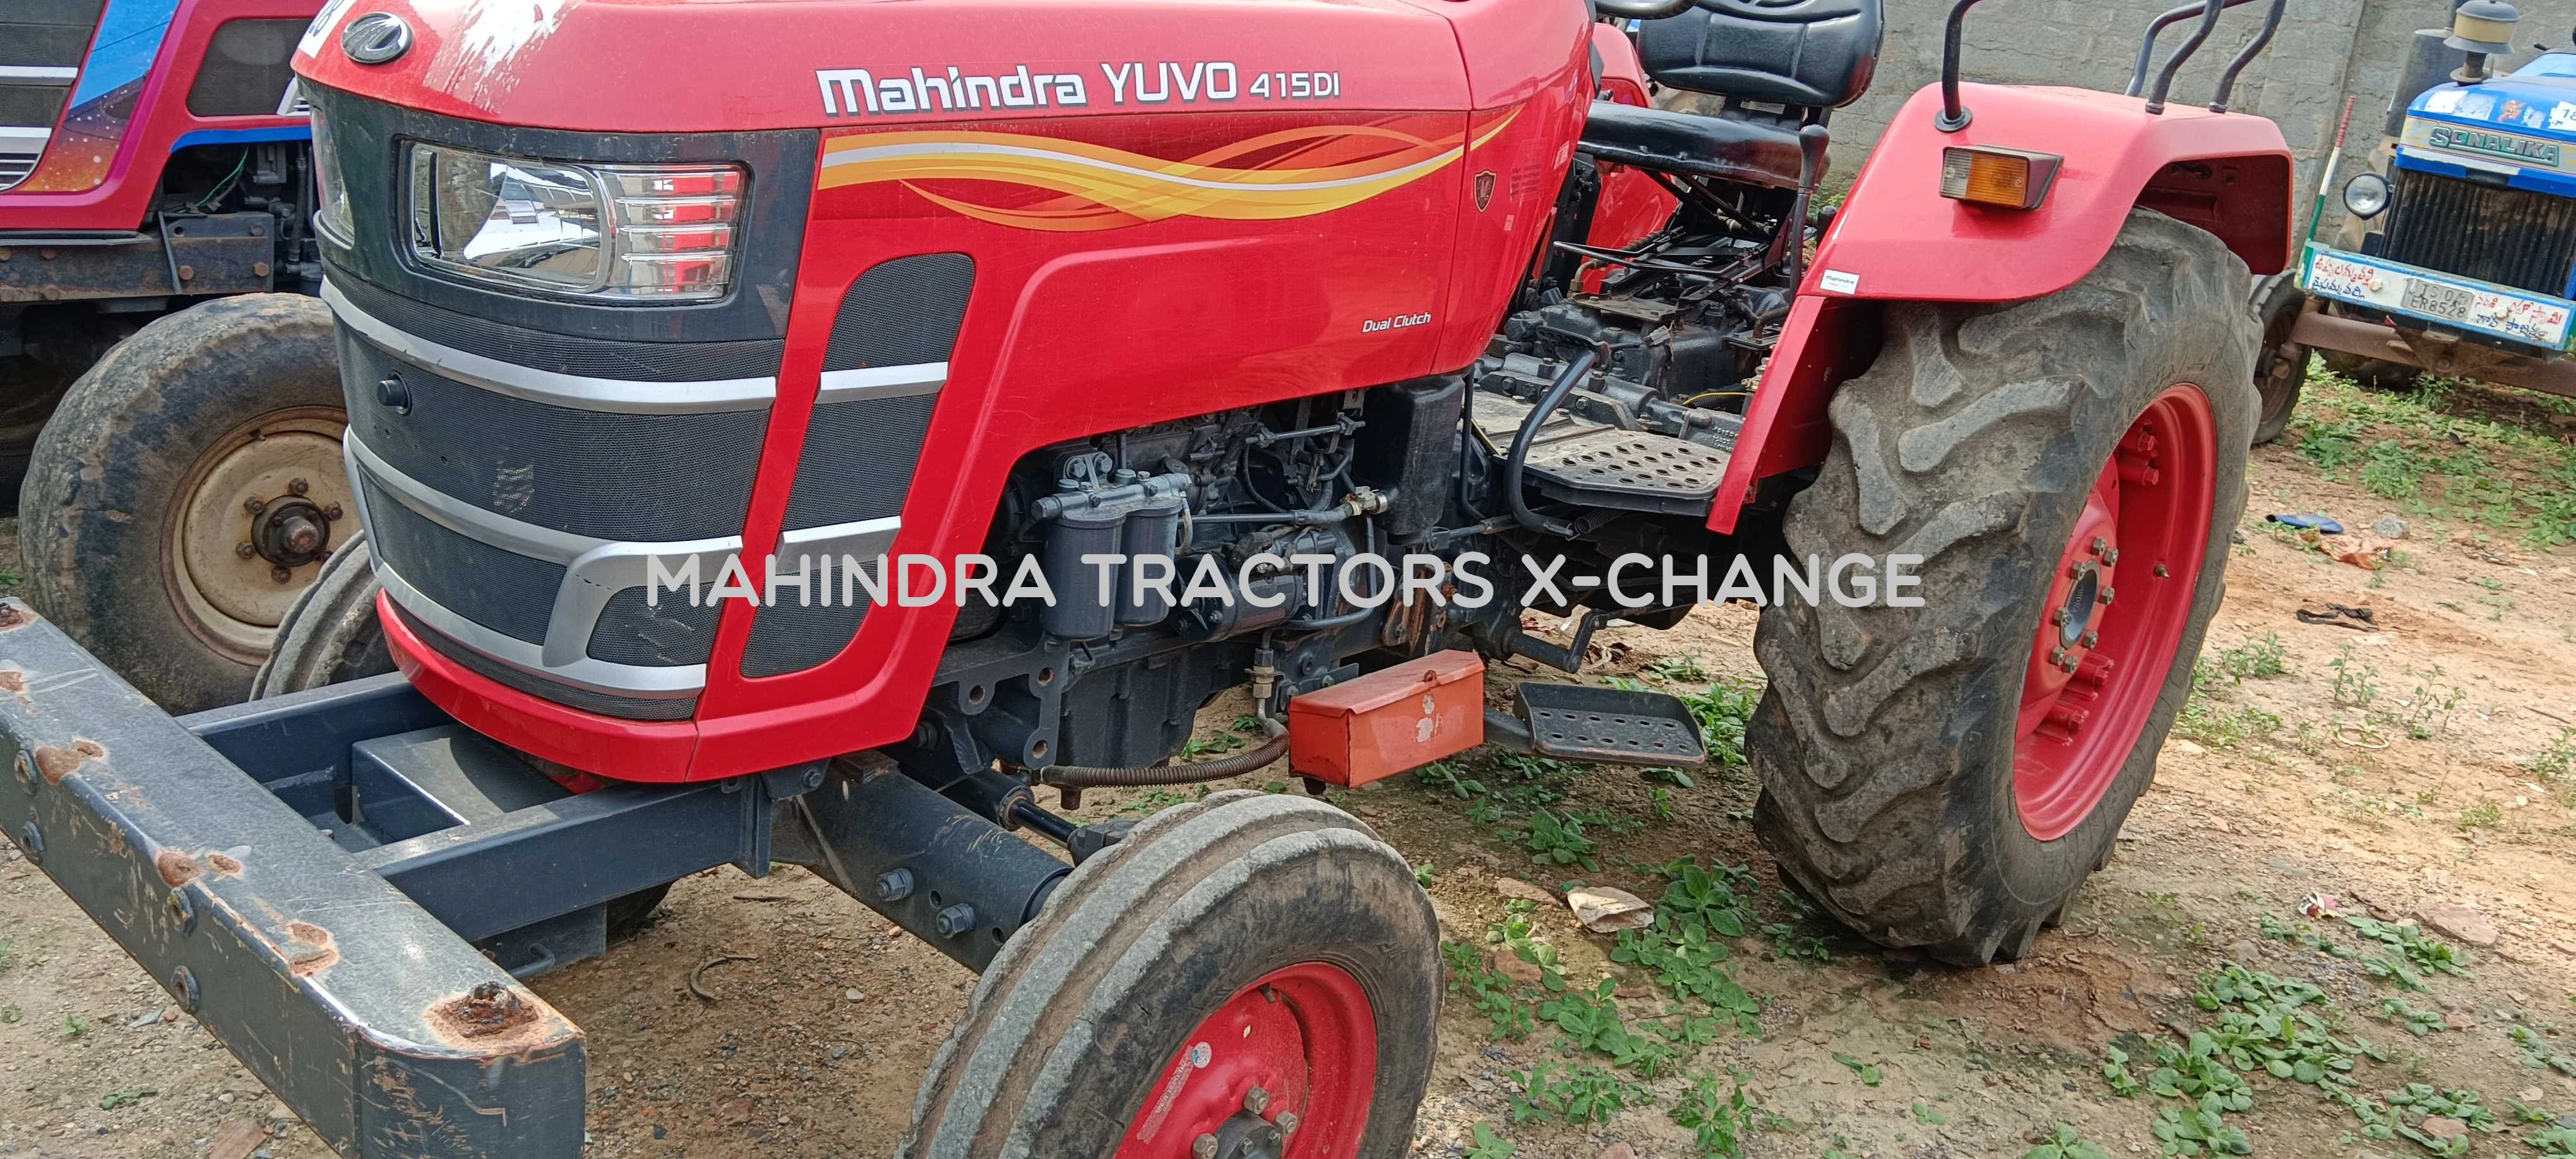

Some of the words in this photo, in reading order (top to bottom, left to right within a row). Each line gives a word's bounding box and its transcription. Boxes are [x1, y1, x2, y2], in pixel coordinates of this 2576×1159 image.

[815, 64, 1088, 116] Mahindra
[1100, 61, 1238, 104] YUVO
[1249, 71, 1341, 98] 415DI
[1361, 317, 1392, 333] Dual
[1393, 311, 1432, 328] Clutch
